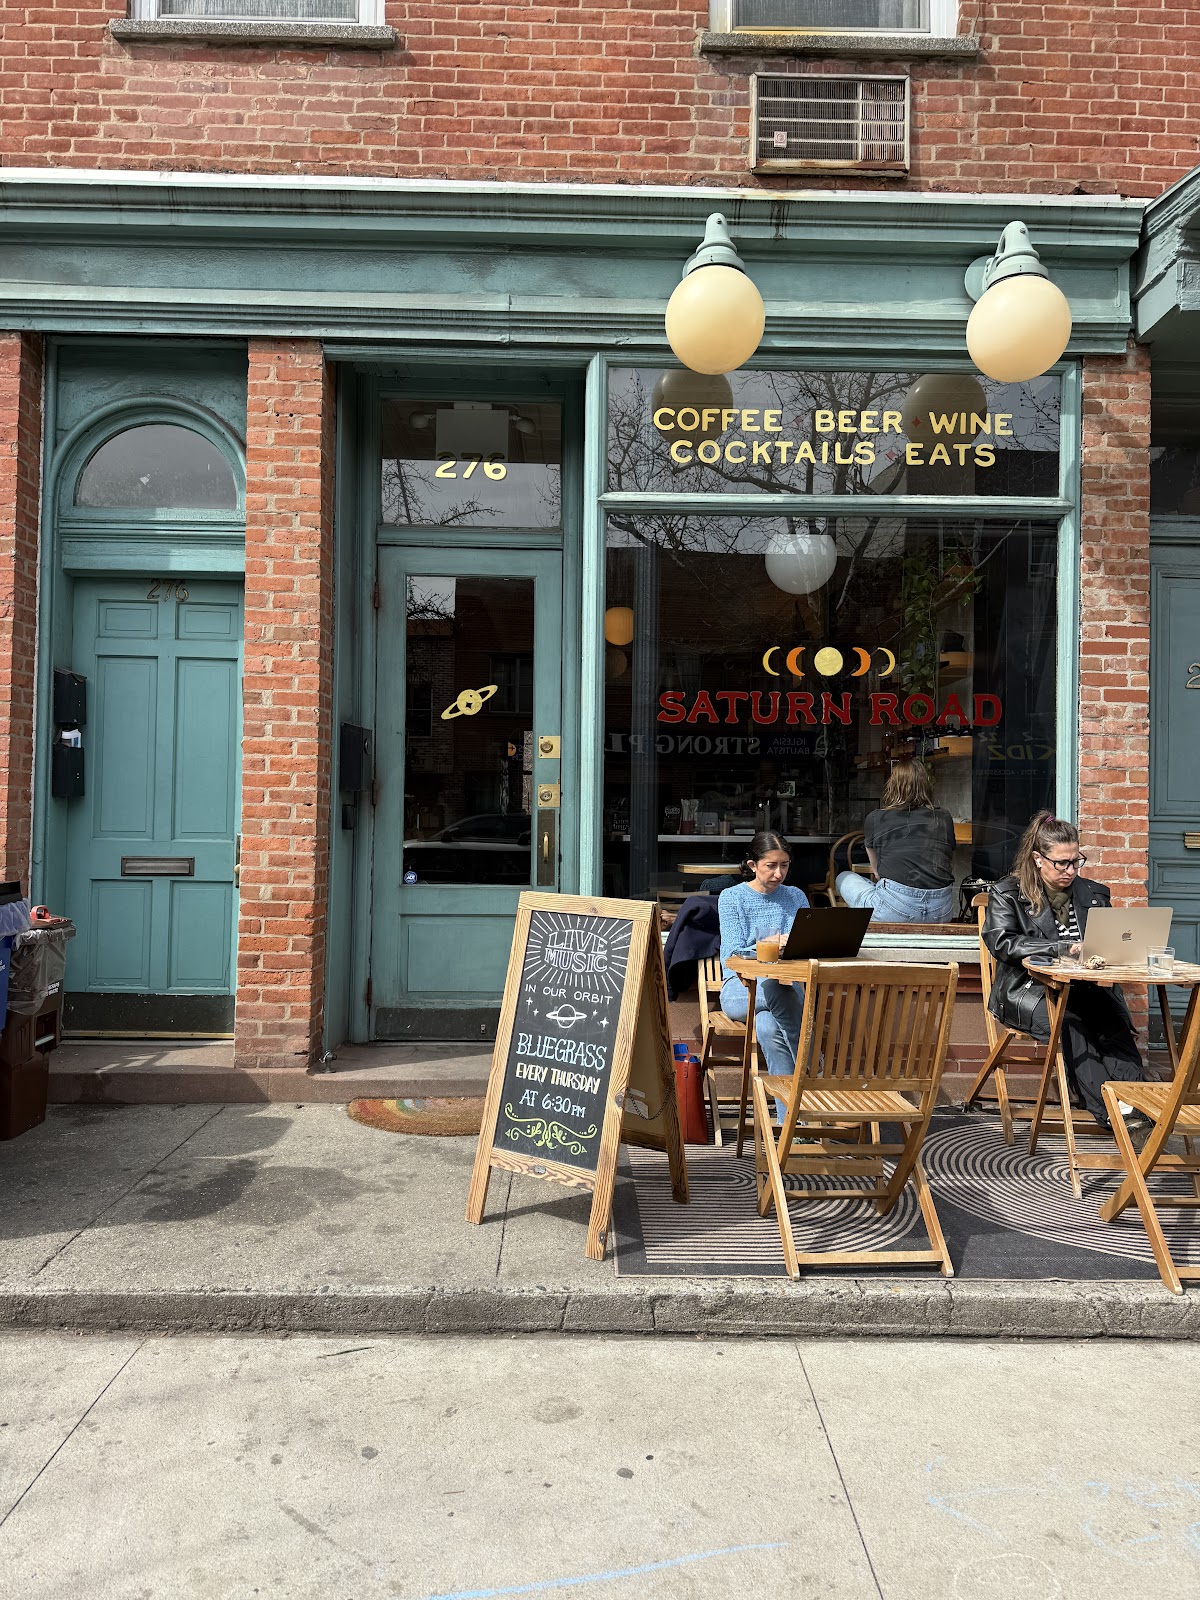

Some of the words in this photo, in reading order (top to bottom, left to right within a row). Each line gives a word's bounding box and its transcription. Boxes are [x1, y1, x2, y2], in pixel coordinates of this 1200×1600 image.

[653, 407, 783, 432] COFFEE
[815, 410, 903, 433] BEER
[929, 411, 1014, 436] WINE
[434, 451, 507, 481] 276
[670, 440, 876, 465] COCKTAILS
[905, 442, 996, 467] EATS
[147, 578, 189, 602] 276
[656, 690, 853, 725] SATURN
[869, 692, 1003, 727] ROAD
[547, 929, 608, 955] LIVE
[544, 948, 608, 973] MUSIC
[525, 984, 537, 993] IN
[542, 986, 567, 999] OUR
[573, 991, 613, 1005] ORBIT
[516, 1033, 607, 1070] BLUEGRASS
[515, 1062, 548, 1084] EVERY
[550, 1068, 601, 1095] THURSDAY
[519, 1089, 538, 1107] AT
